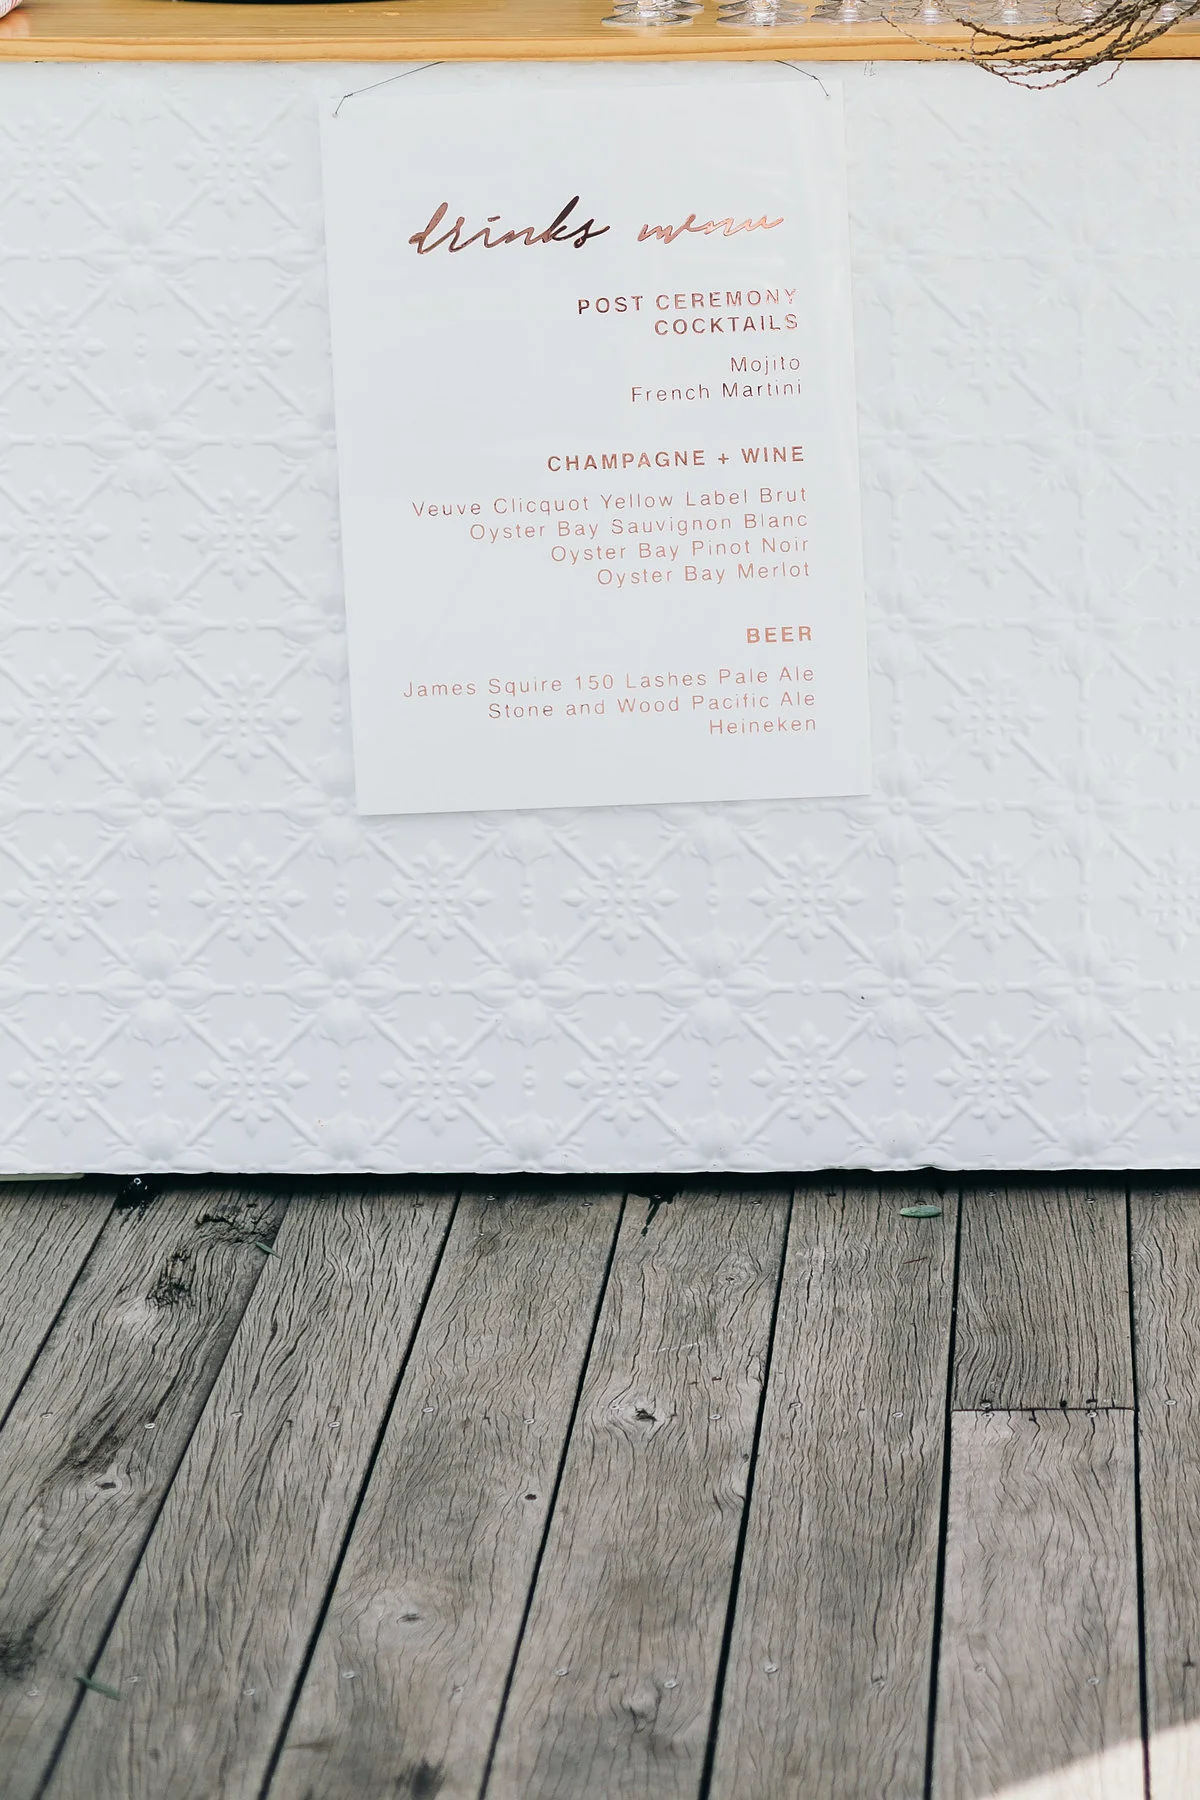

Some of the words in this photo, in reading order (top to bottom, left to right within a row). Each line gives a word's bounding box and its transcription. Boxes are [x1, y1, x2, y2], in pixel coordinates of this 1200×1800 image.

[408, 195, 611, 255] drinks
[637, 213, 784, 245] menu
[577, 296, 644, 314] POST
[655, 288, 796, 311] CEREMONY
[654, 313, 798, 336] COCKTAILS
[730, 355, 800, 376] Mojito
[631, 384, 710, 403] French
[722, 379, 801, 399] Martini
[546, 449, 705, 472] CHAMPAGNE
[740, 445, 805, 464] WINE
[412, 502, 480, 517] Veuve
[493, 497, 588, 516] Clicquot
[600, 493, 673, 510] Yellow
[686, 489, 748, 507] Label
[760, 487, 807, 504] Brut
[470, 522, 545, 544] Oyster
[557, 520, 598, 539] Bay
[612, 518, 732, 536] Sauvignon
[744, 513, 807, 528] Blanc
[551, 545, 626, 565] Oyster
[639, 542, 679, 561] Bay
[692, 540, 750, 556] Pinot
[762, 537, 808, 553] Noir
[598, 568, 672, 588] Oyster
[684, 565, 725, 584] Bay
[737, 562, 809, 579] Merlot
[745, 625, 812, 644] BEER
[404, 682, 476, 697] James
[489, 677, 561, 697] Squire
[576, 673, 613, 690] 150
[626, 672, 707, 688] Lashes
[719, 668, 767, 685] Pale
[779, 666, 814, 682] Ale
[488, 703, 553, 719] Stone
[566, 700, 604, 716] and
[617, 696, 679, 713] Wood
[692, 693, 768, 710] Pacific
[781, 692, 814, 706] Ale
[710, 717, 815, 735] Heineken
